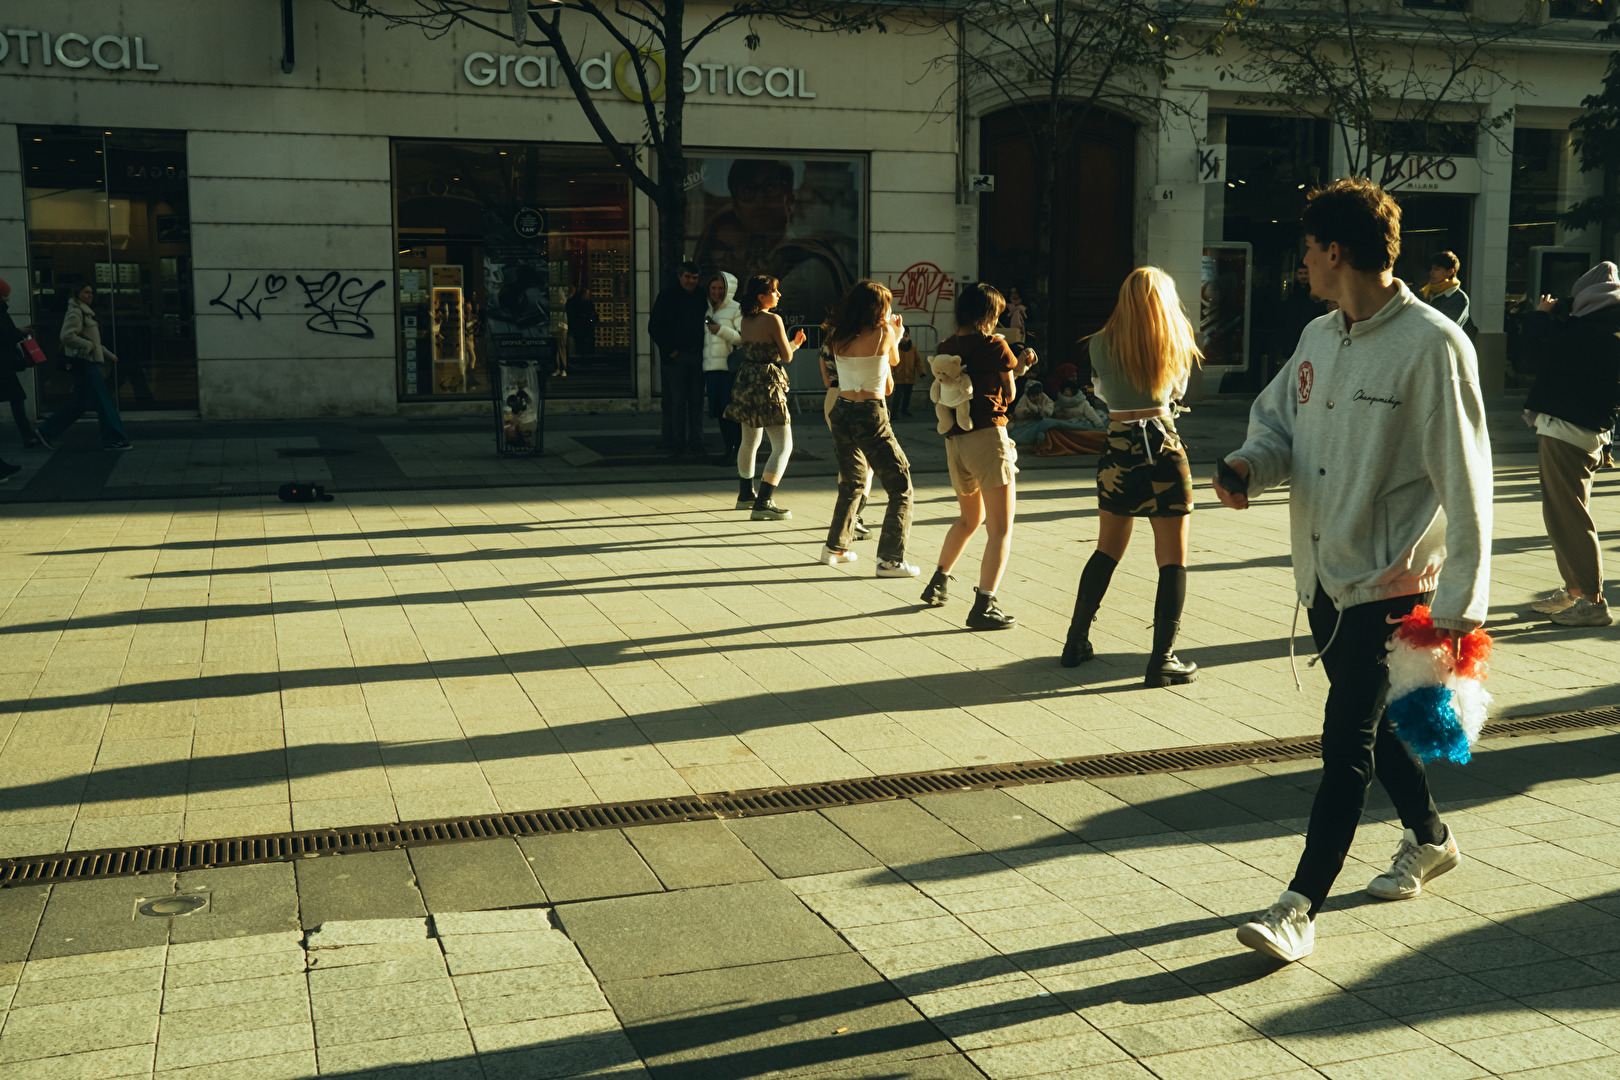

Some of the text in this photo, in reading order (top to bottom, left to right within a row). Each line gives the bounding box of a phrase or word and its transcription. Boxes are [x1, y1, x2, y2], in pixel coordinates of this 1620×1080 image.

[1387, 158, 1457, 181] KIKO
[1162, 190, 1174, 200] 61
[784, 315, 805, 325] 1917
